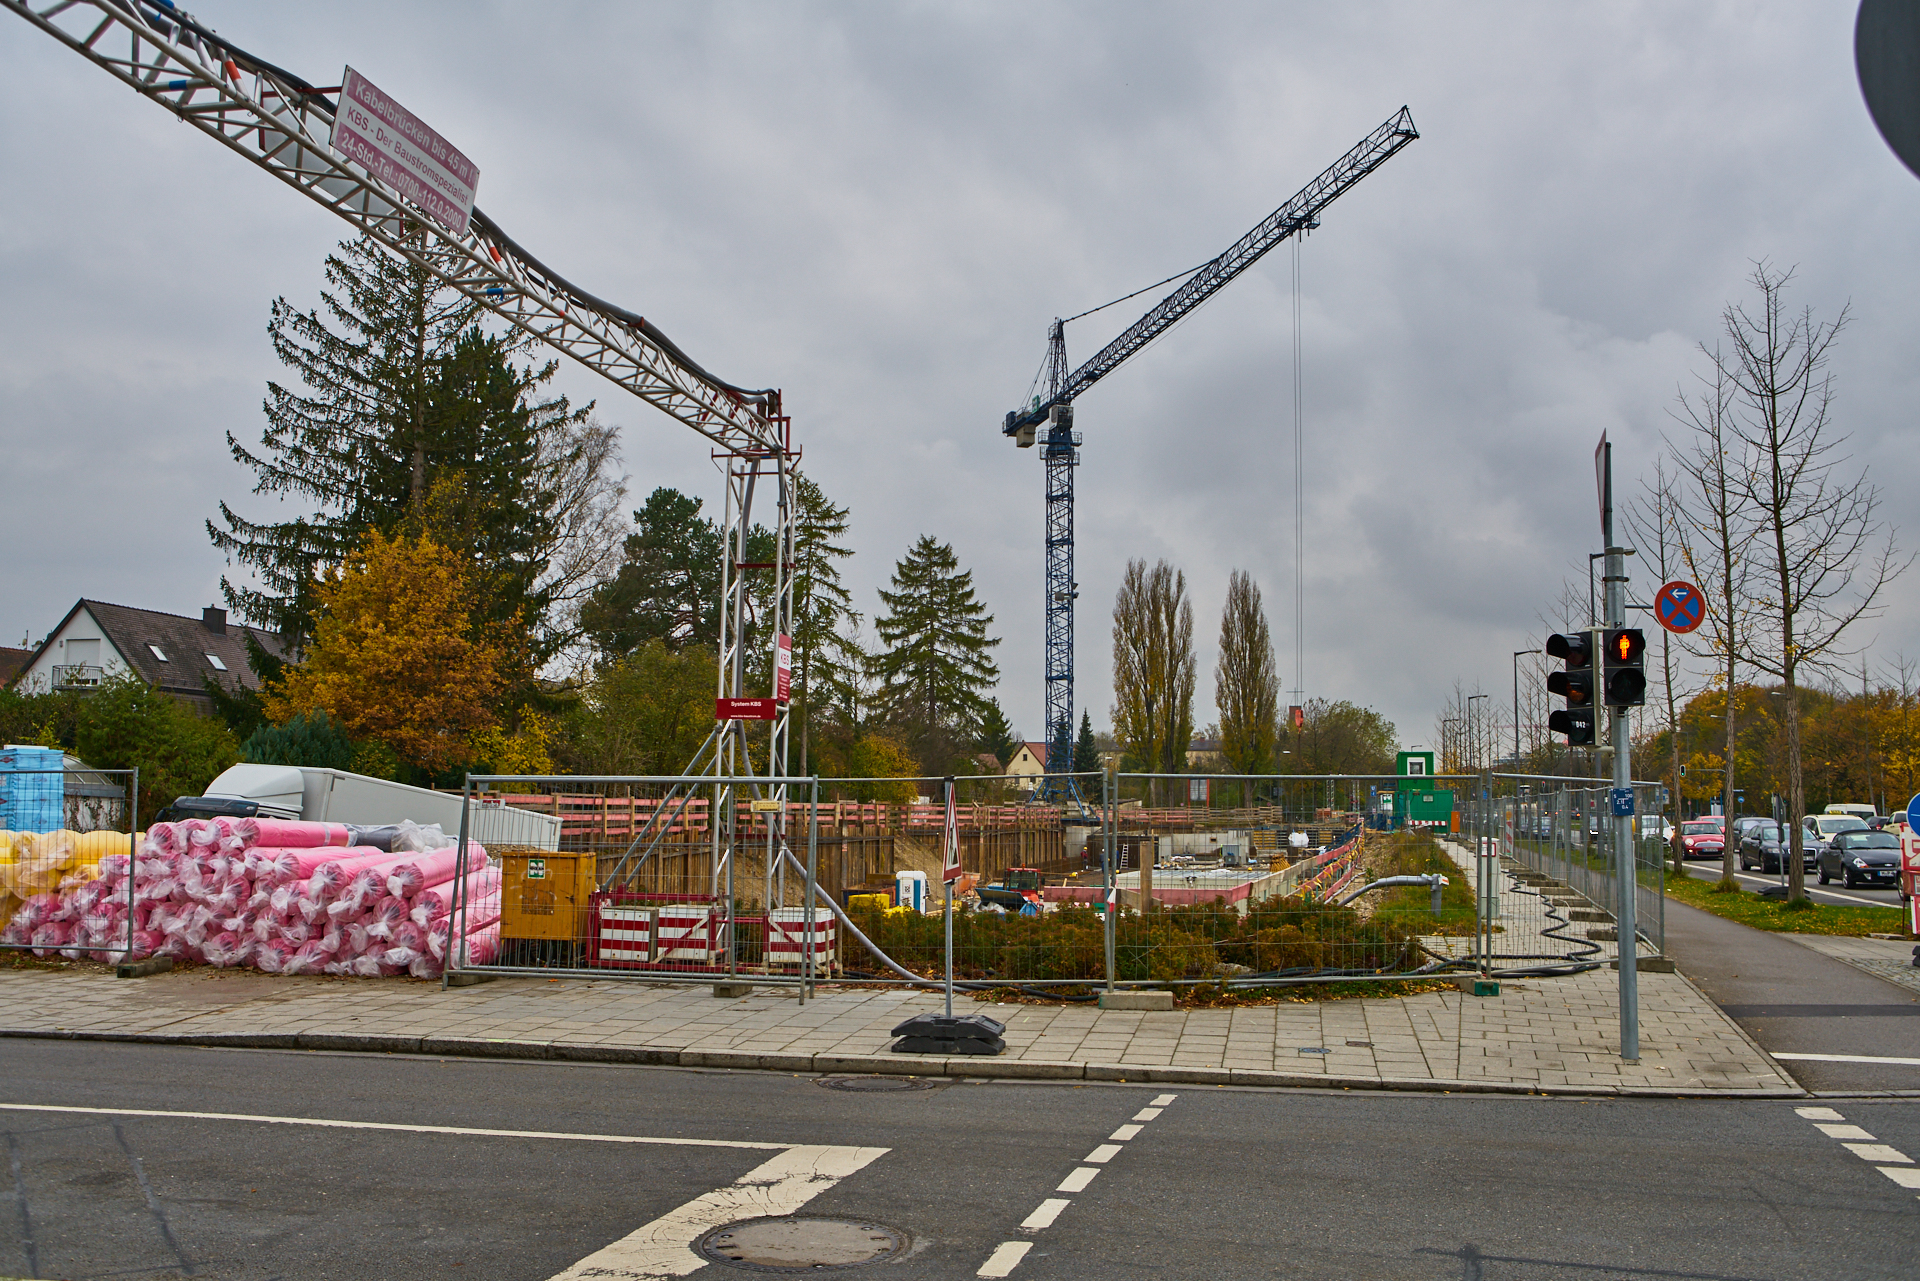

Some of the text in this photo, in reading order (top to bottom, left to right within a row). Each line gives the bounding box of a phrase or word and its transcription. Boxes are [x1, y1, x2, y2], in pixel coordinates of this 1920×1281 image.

[341, 132, 462, 229] 24-Std.-Tel.: 0700-112.0.2000
[347, 106, 369, 131] KBS
[376, 127, 393, 148] Der
[394, 142, 469, 206] Baustromspezialist
[355, 80, 473, 182] Kabelbrücken bis 45 m !
